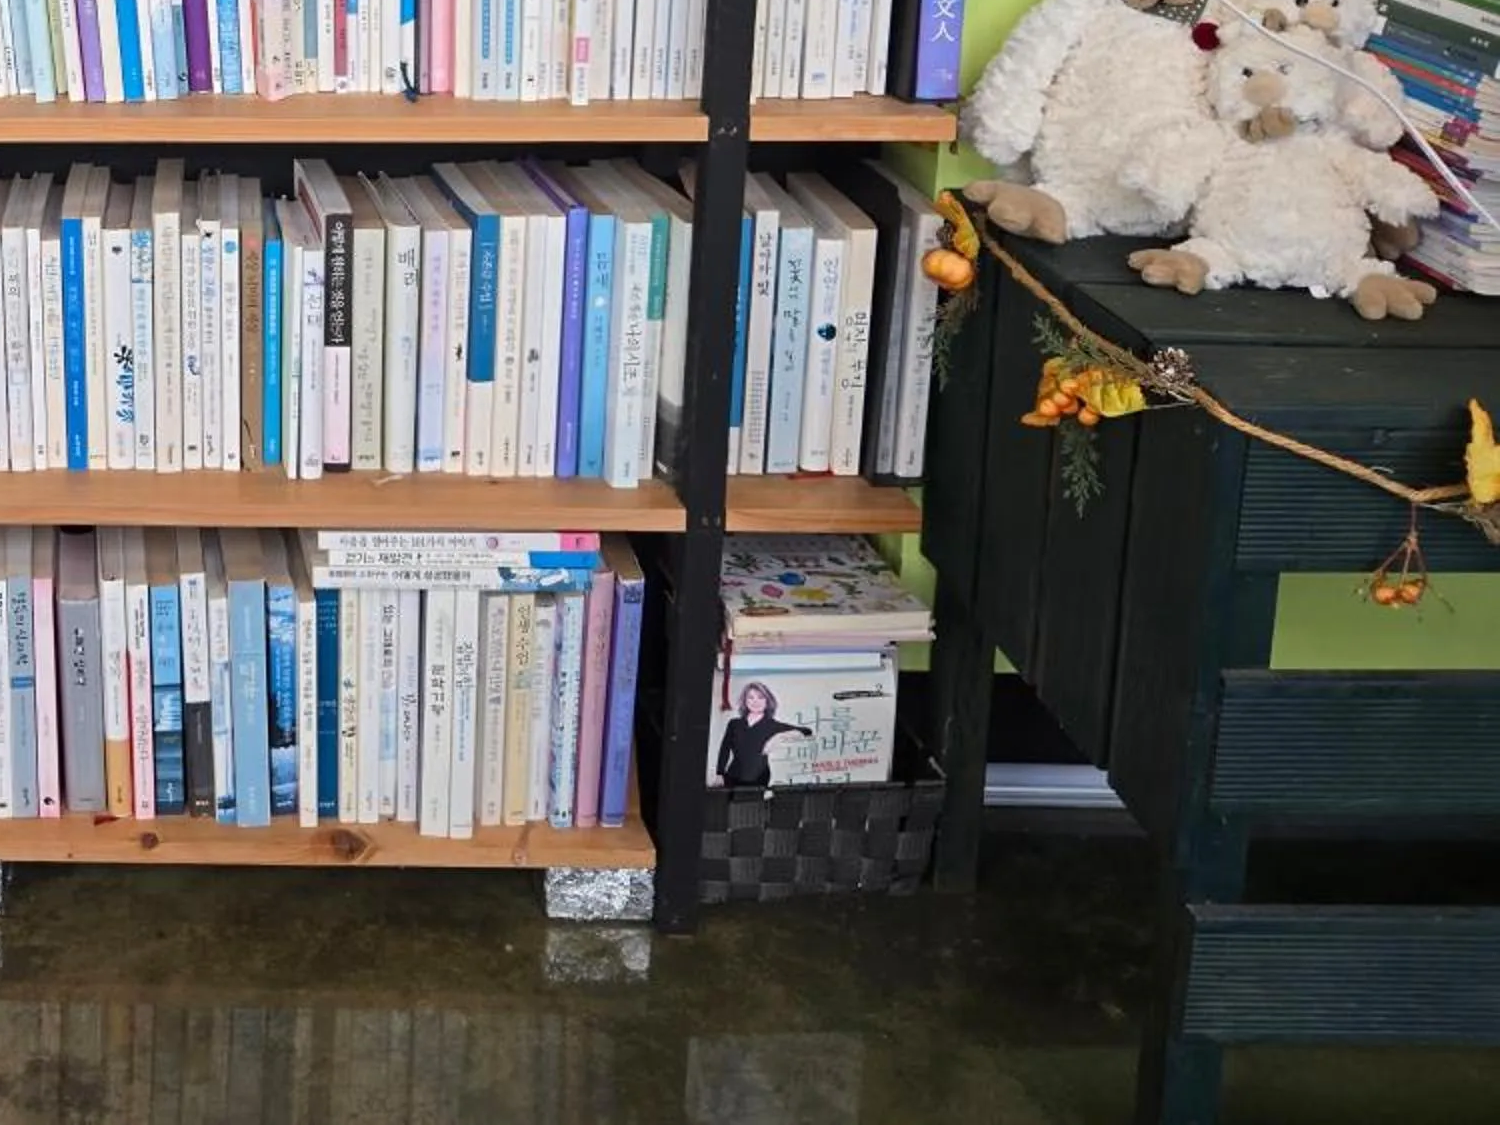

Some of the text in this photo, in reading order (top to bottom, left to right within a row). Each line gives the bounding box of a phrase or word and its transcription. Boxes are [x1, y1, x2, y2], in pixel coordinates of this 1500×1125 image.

[331, 221, 345, 345] 어떻게 원하는 것을 얻는가
[479, 280, 492, 304] 수업
[18, 630, 29, 666] 심리학
[795, 706, 857, 736] 나를
[821, 730, 882, 756] 바꾼
